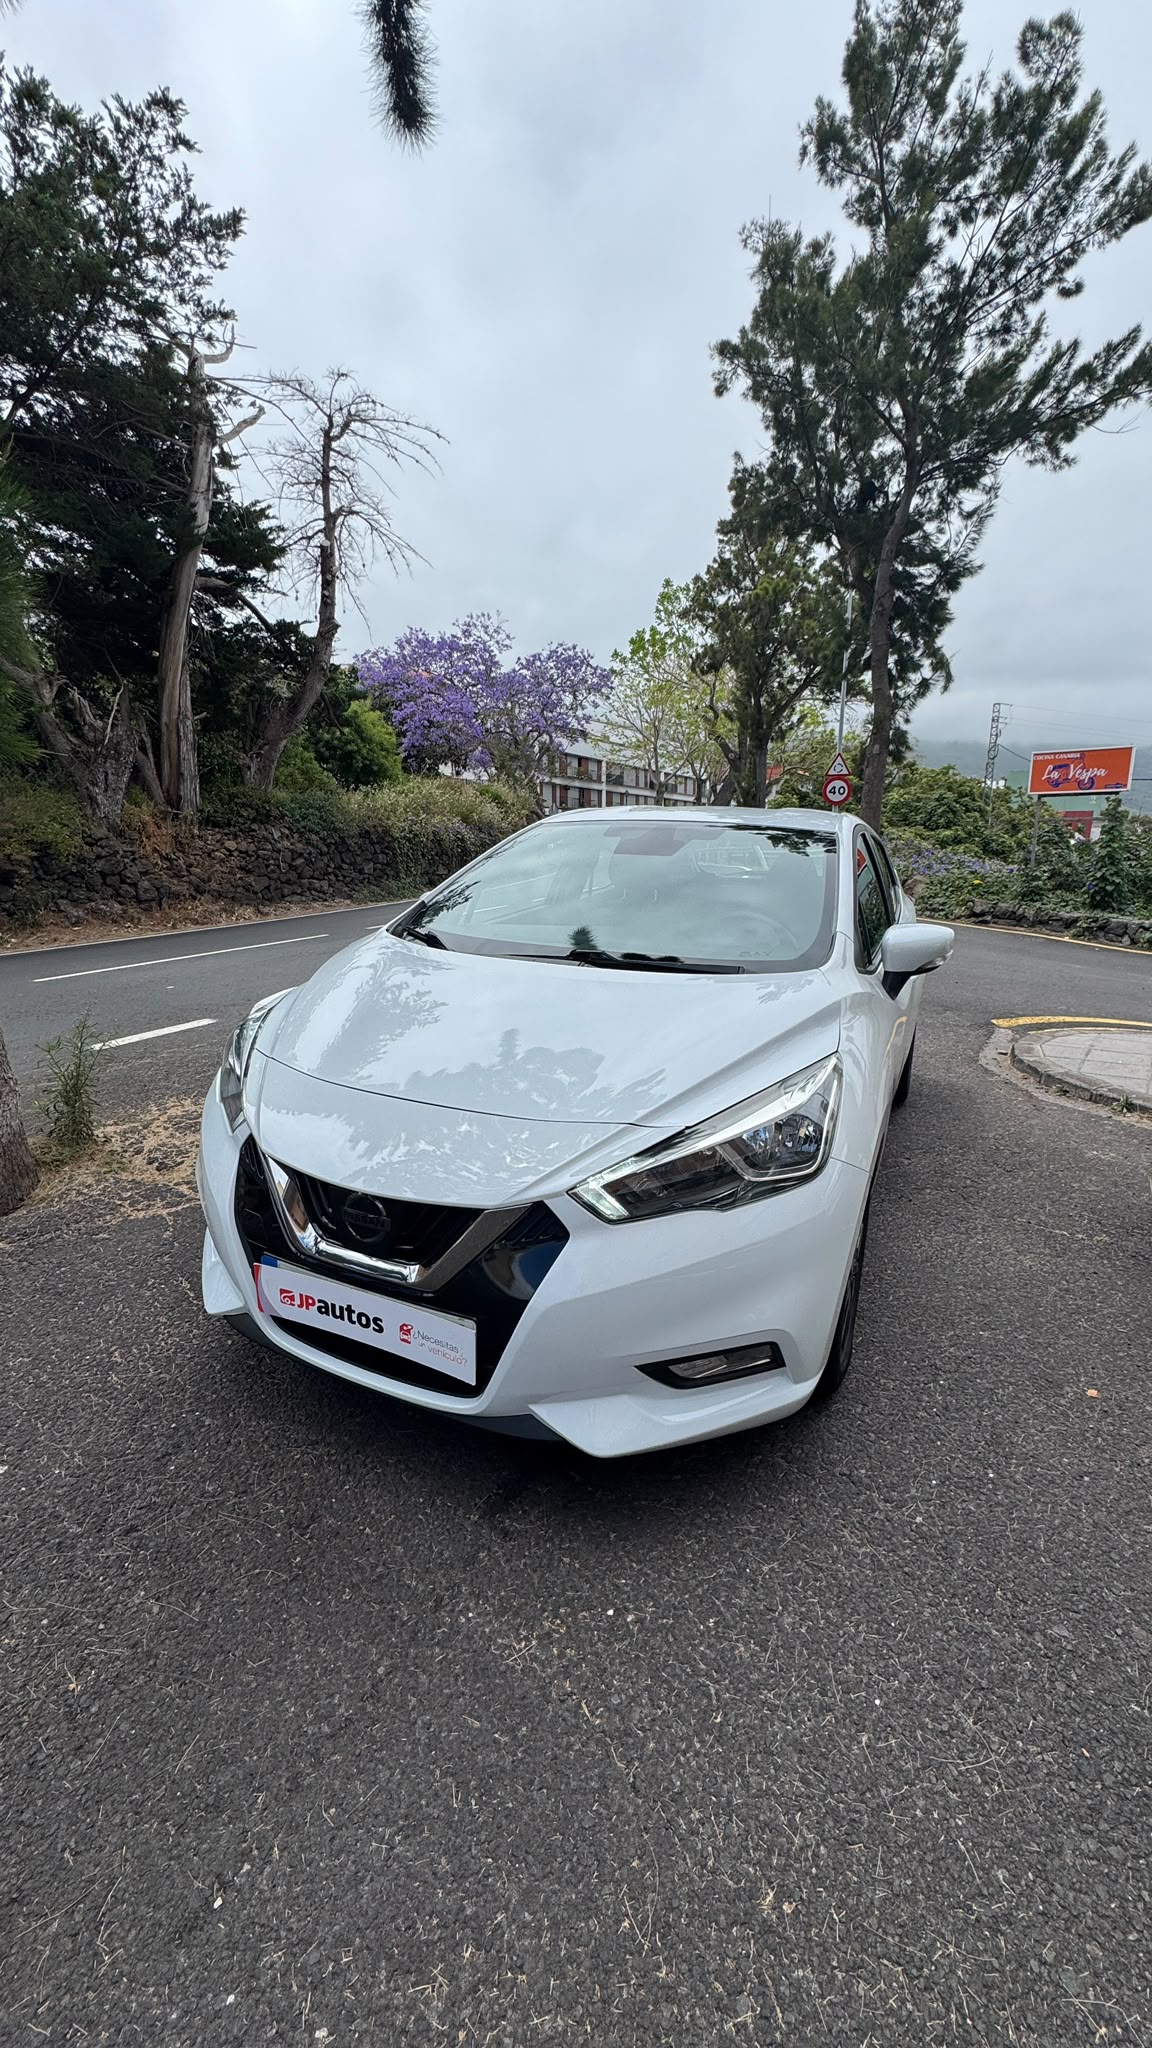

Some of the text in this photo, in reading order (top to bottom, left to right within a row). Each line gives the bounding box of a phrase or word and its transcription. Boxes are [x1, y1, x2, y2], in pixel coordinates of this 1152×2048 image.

[1041, 763, 1108, 784] La Vespa
[828, 786, 846, 795] 40
[297, 1293, 384, 1334] JPautos
[412, 1330, 459, 1354] ¿Necesitas
